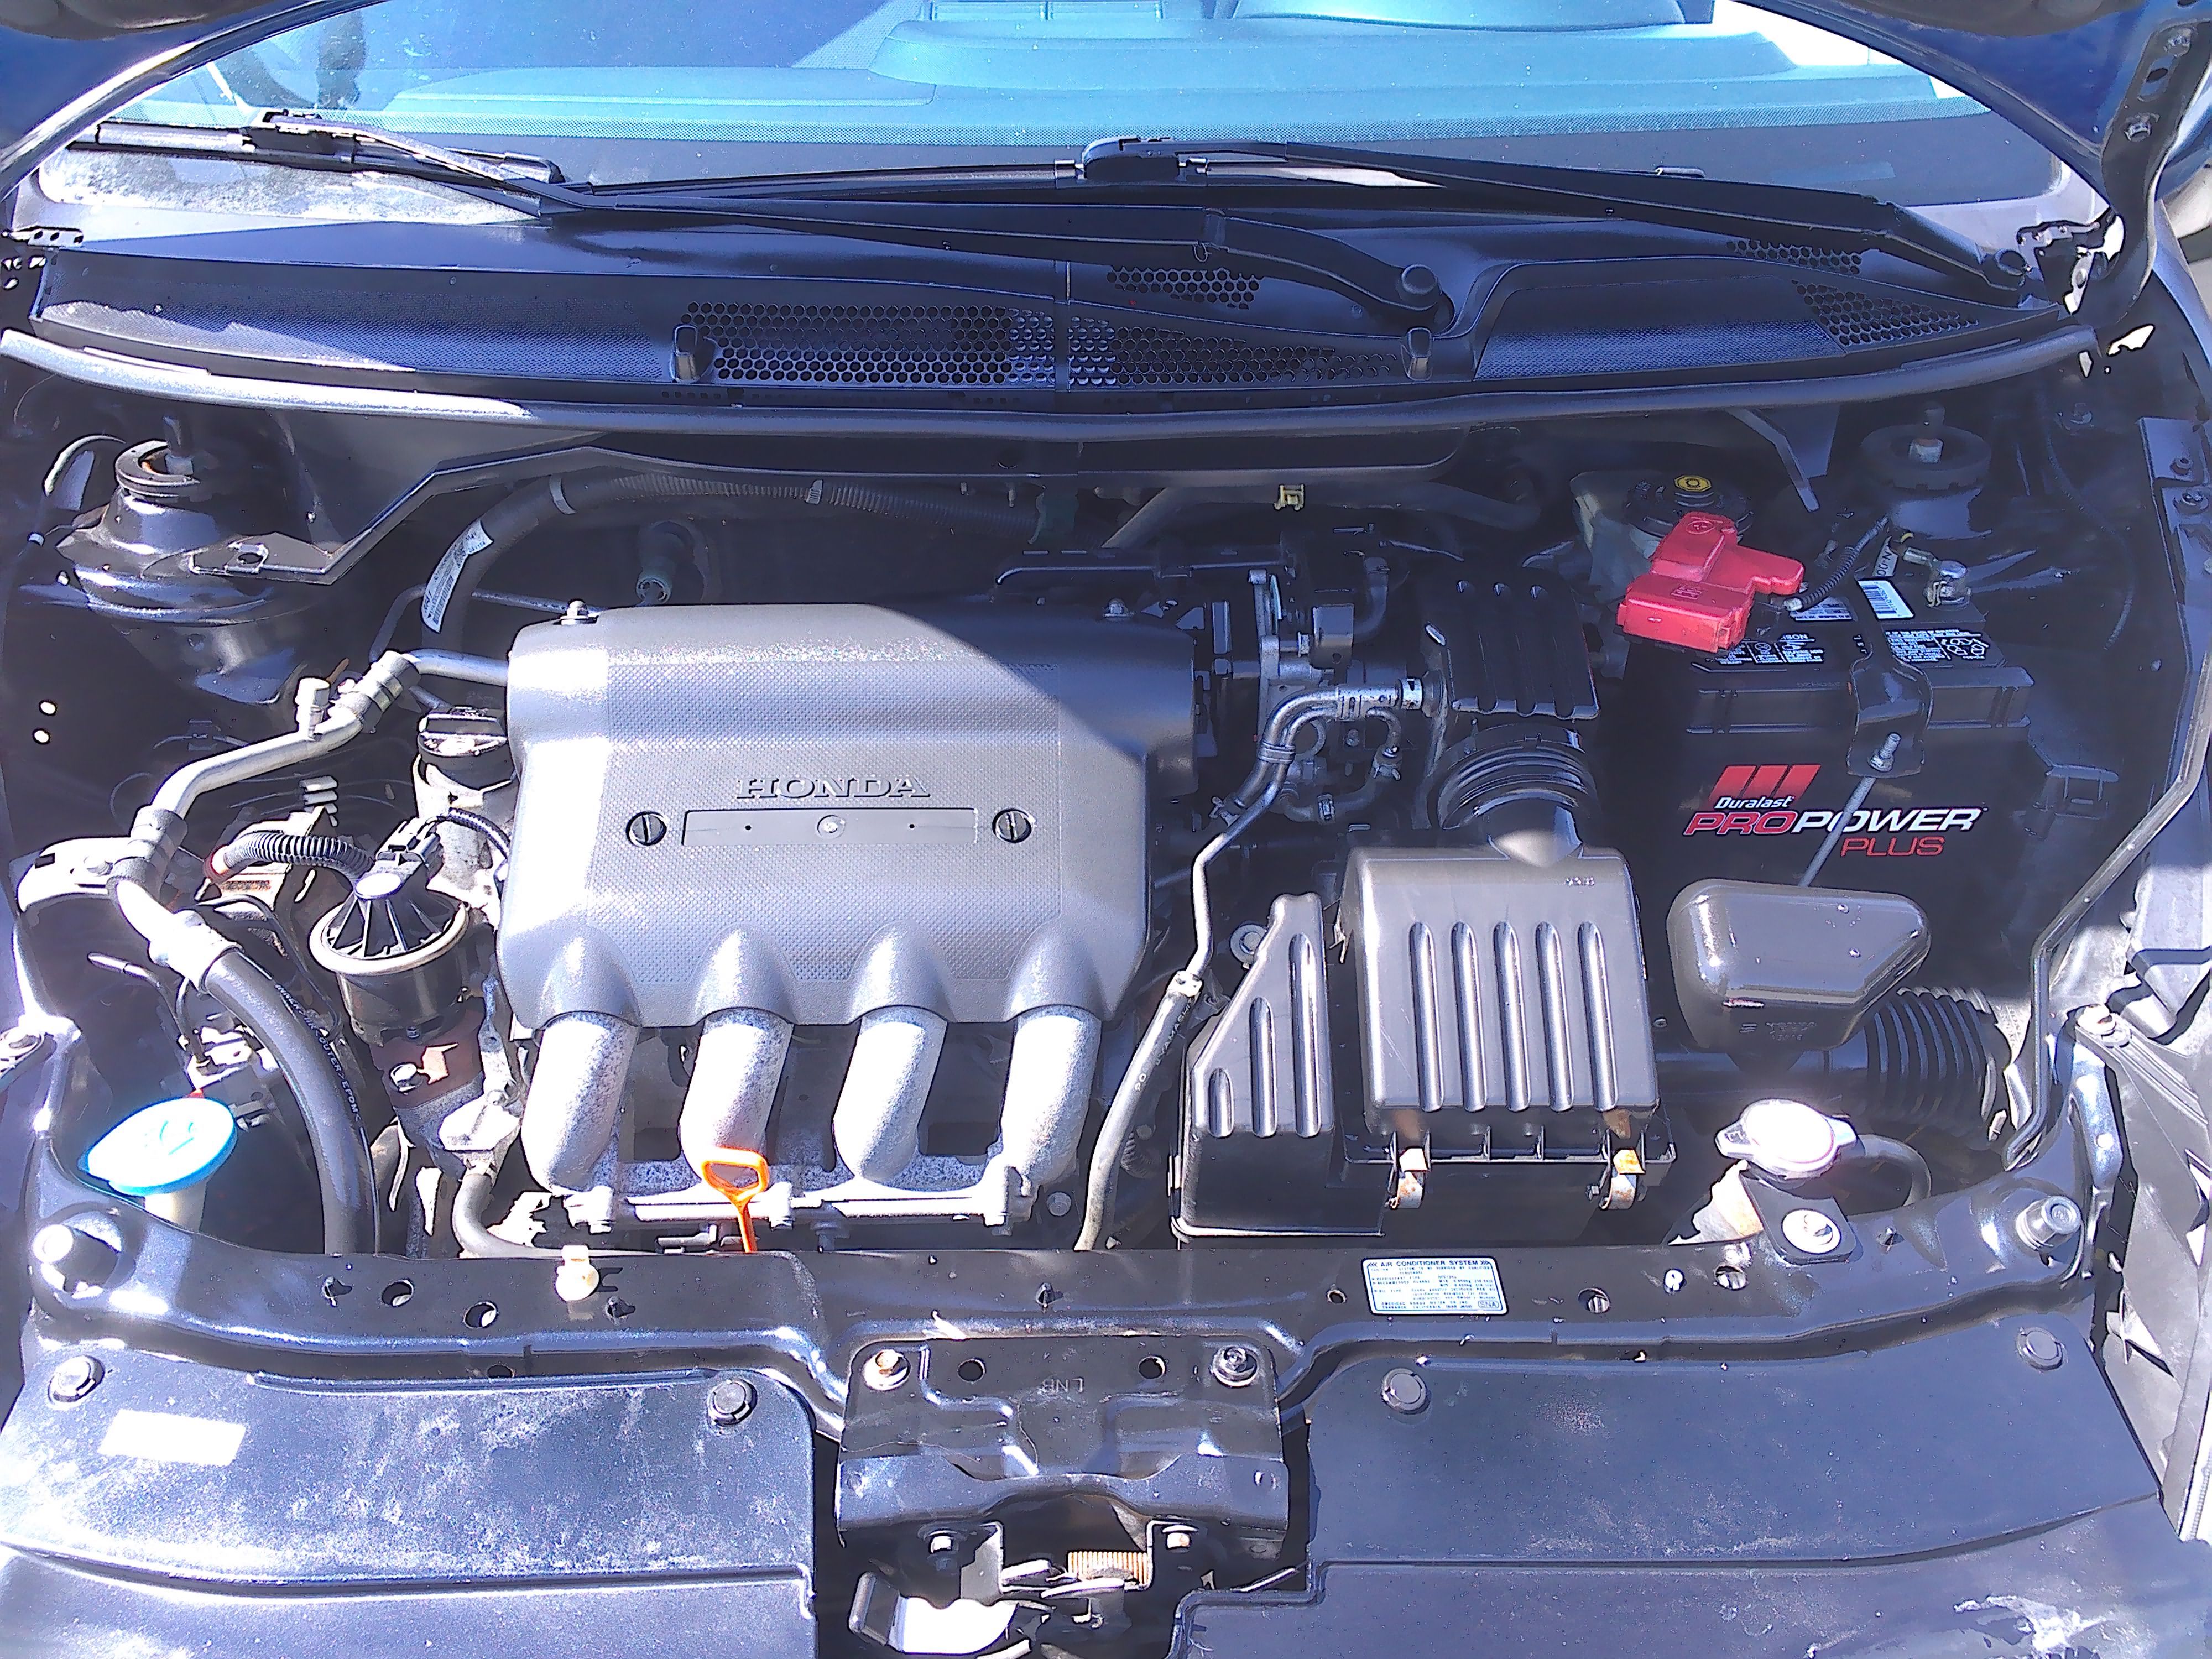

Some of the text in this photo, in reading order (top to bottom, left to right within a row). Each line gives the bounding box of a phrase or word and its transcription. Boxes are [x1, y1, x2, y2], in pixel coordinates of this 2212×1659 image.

[735, 775, 931, 799] HONDA
[1714, 796, 1796, 810] Duralast
[1840, 837, 1945, 857] PLUS
